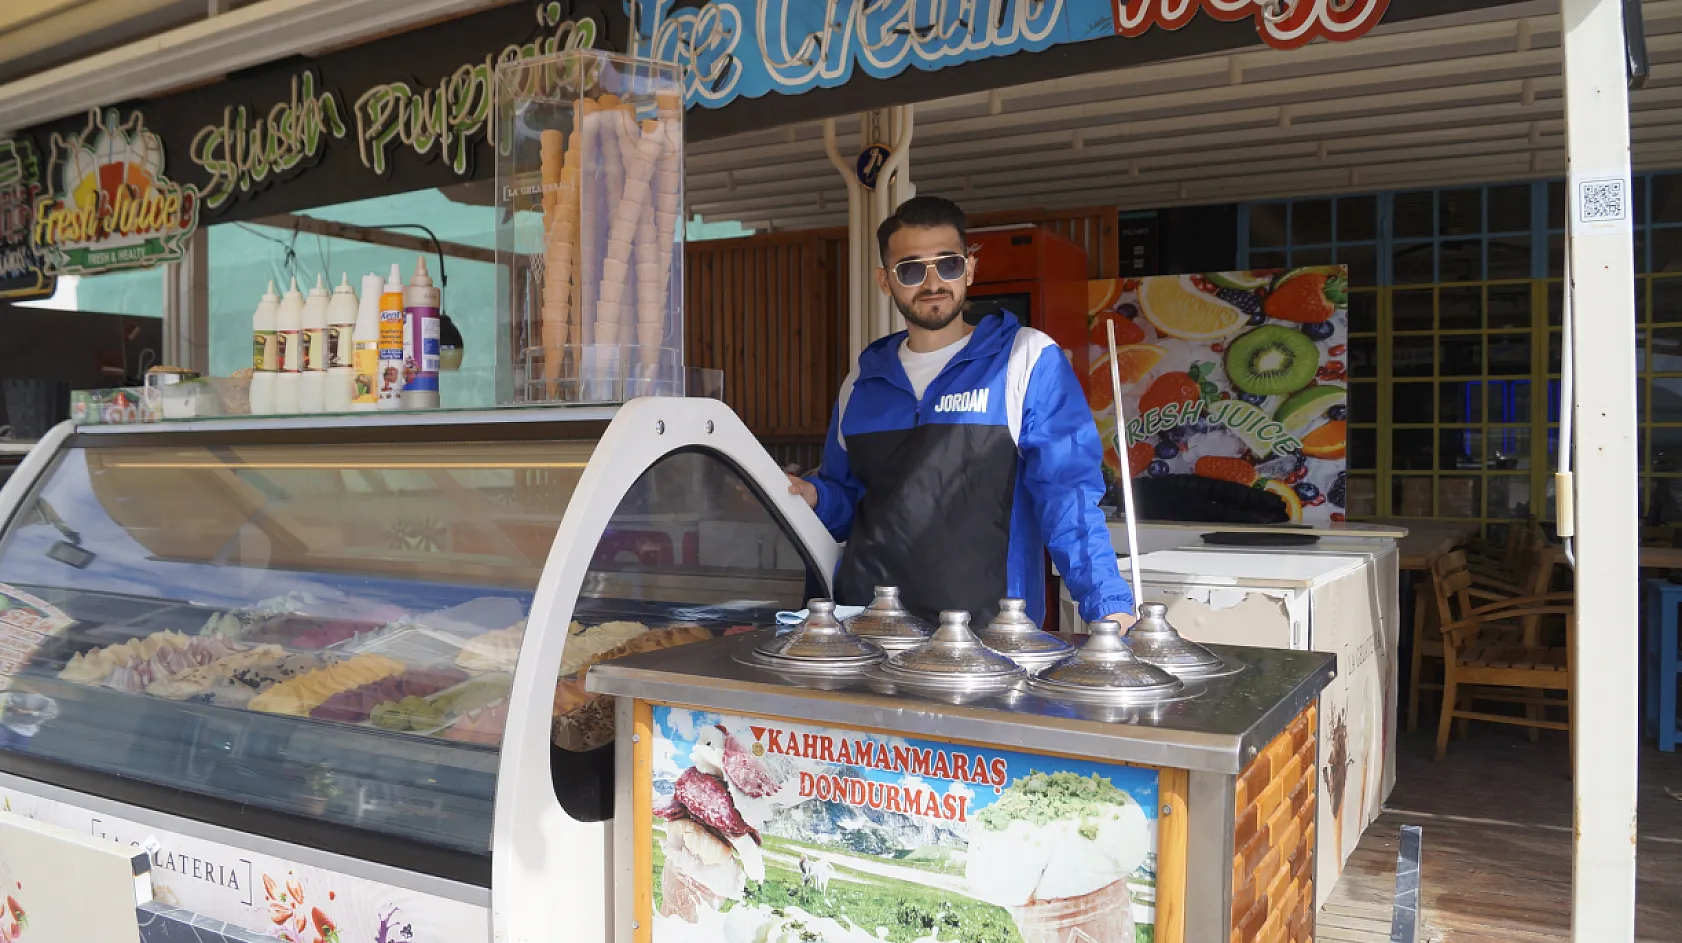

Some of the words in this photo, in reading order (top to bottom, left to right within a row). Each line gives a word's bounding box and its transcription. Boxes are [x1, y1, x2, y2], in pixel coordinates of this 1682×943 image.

[190, 70, 345, 208] Slush
[36, 188, 104, 247] Fresh
[103, 182, 186, 236] Juice
[935, 388, 990, 413] JORDAN
[1207, 402, 1303, 457] JUICE
[767, 729, 1007, 795] KAHRAMANMARAŞ
[799, 770, 968, 823] DONDURMASI
